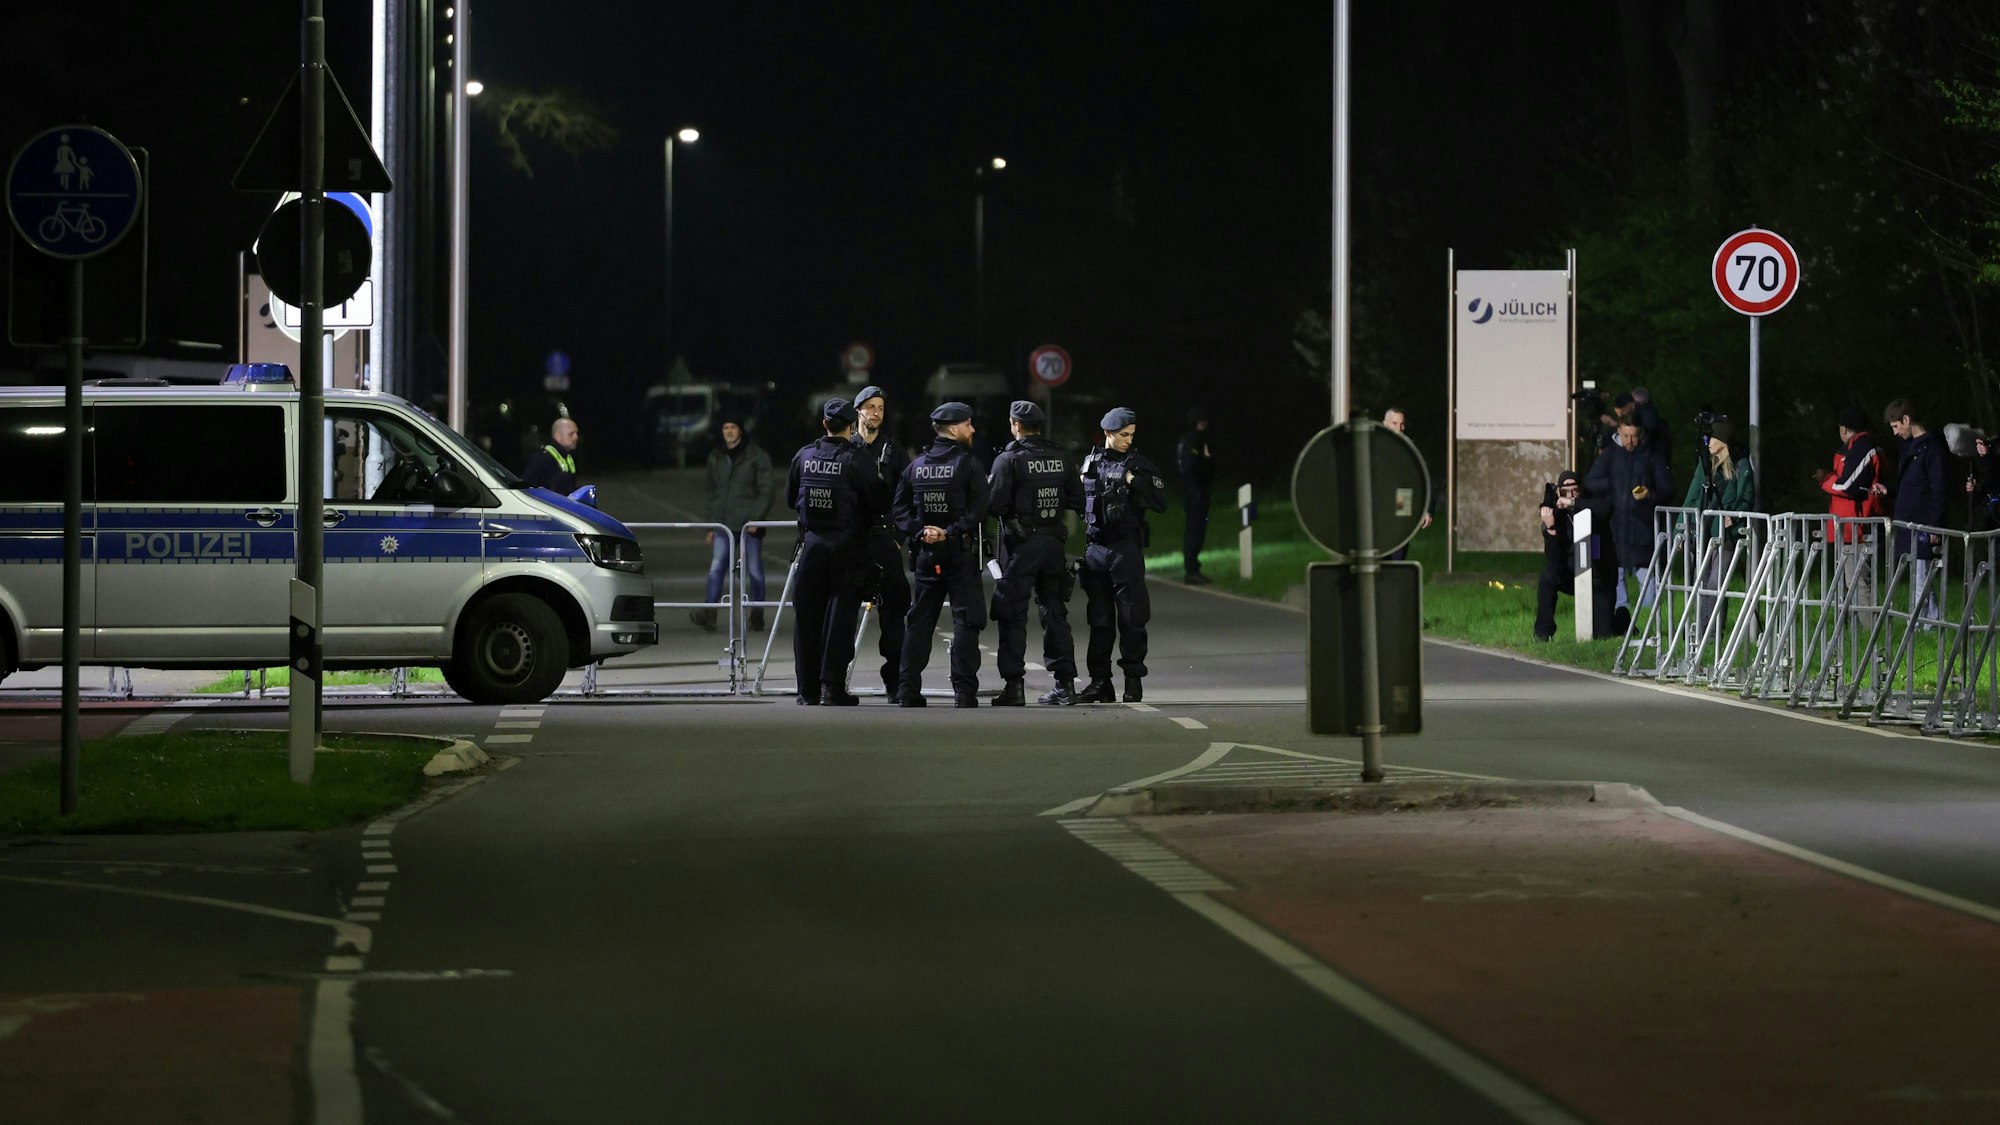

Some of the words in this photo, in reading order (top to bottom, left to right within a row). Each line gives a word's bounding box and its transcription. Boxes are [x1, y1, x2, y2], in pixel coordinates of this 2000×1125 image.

[1736, 256, 1779, 291] 70
[1499, 299, 1557, 315] JÜLICH
[1041, 357, 1063, 375] 70
[804, 460, 842, 475] POLIZEI
[915, 465, 954, 479] POLIZEI
[1027, 459, 1064, 474] POLIZEI
[809, 488, 831, 498] NRW
[923, 492, 945, 502] NRW
[1038, 487, 1058, 498] NRW
[808, 498, 833, 508] 31322
[924, 503, 948, 513] 31322
[1037, 498, 1059, 508] 31322
[126, 533, 251, 557] POLIZEI
